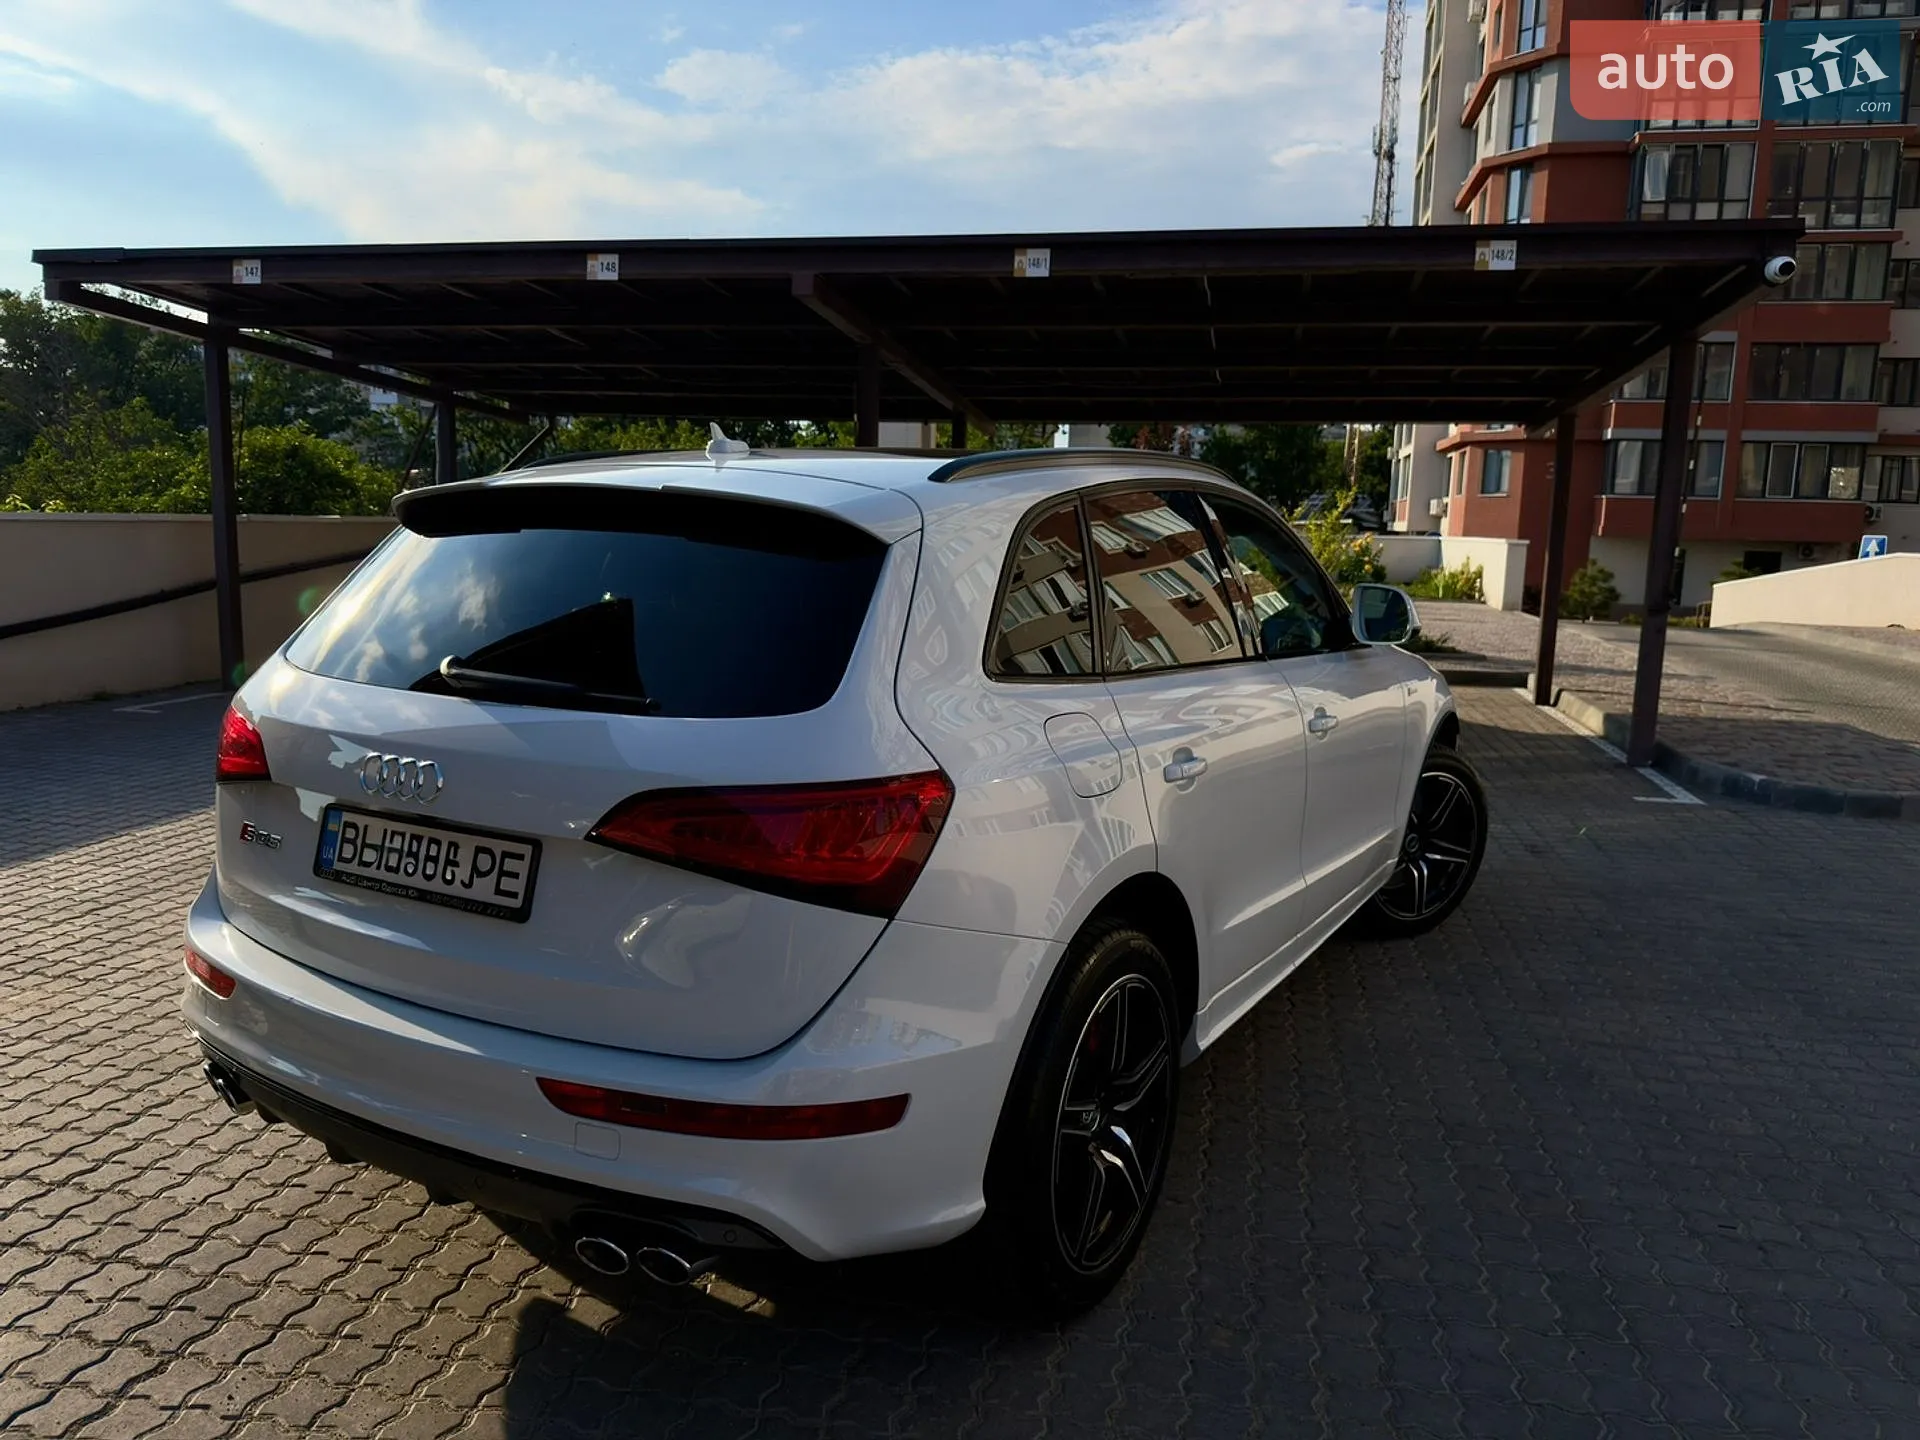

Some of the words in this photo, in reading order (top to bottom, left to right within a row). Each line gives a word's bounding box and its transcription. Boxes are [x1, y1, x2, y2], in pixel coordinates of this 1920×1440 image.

[1491, 248, 1514, 261] 148/2
[244, 265, 259, 277] 147
[600, 261, 617, 273] 148
[322, 845, 334, 860] UA
